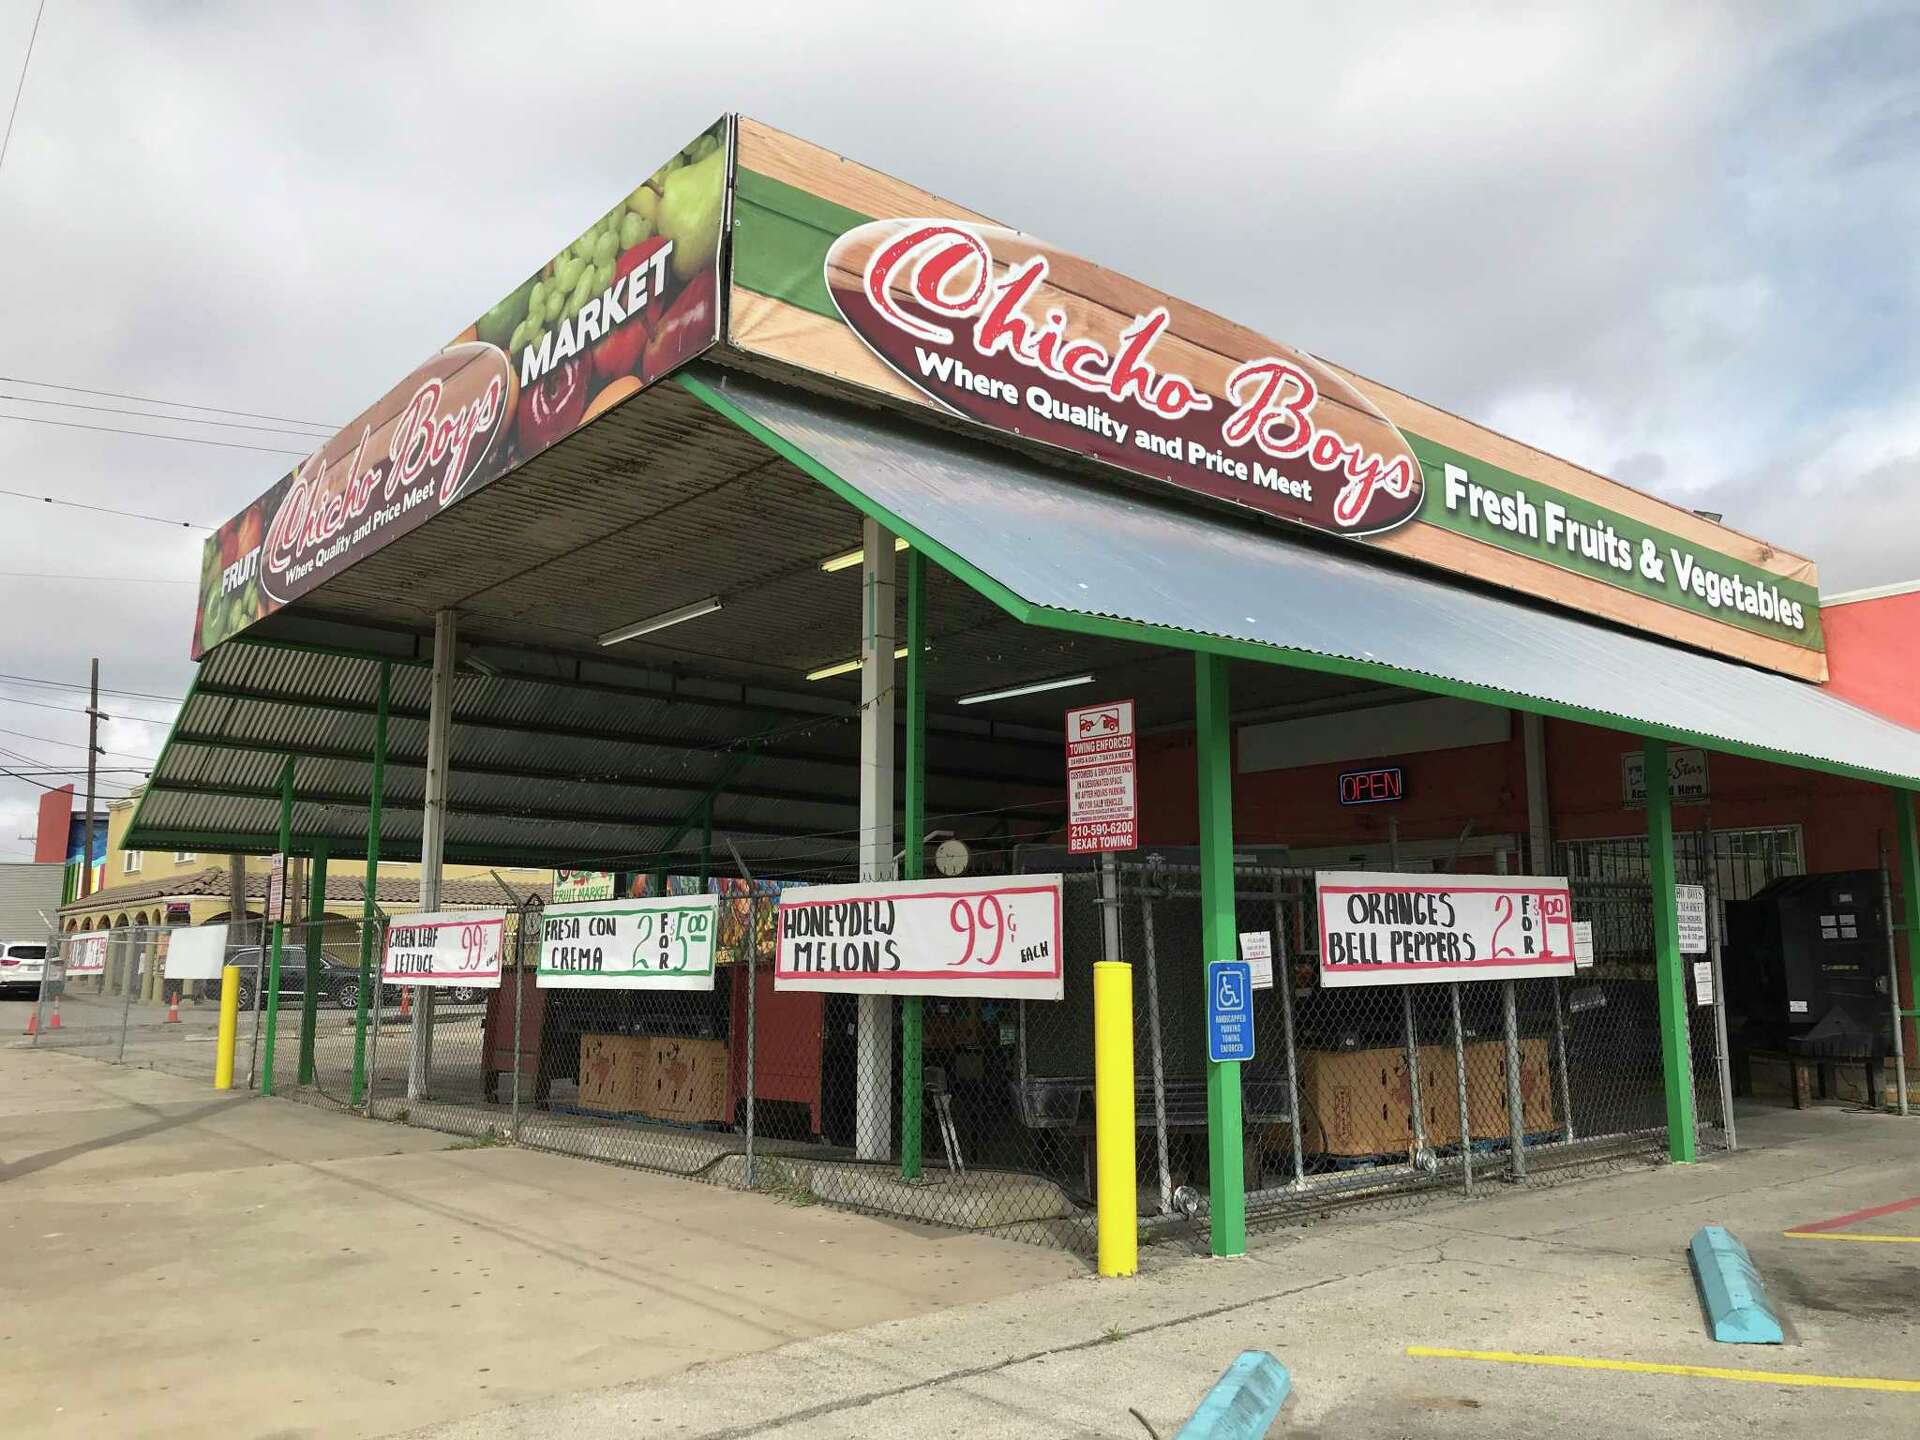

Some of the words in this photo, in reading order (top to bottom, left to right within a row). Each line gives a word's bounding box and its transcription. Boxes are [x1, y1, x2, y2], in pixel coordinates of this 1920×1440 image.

[520, 239, 673, 388] MARKET
[864, 220, 1212, 417] Chicho
[1222, 357, 1413, 525] Boys
[385, 376, 501, 506] Boys
[914, 346, 1020, 406] Where
[1026, 389, 1129, 444] Quality
[1135, 426, 1183, 461] and
[1188, 441, 1248, 482] Price
[1252, 461, 1313, 503] Meet
[284, 555, 314, 588] Where
[315, 533, 351, 571] Quality
[352, 516, 373, 545] and
[372, 502, 402, 533] Price
[402, 477, 436, 515] Meet
[1444, 462, 1538, 539] Fresh
[1544, 500, 1632, 571] Fruits
[1639, 538, 1665, 584] &
[1670, 547, 1804, 630] Vegetables
[220, 545, 261, 599] FRUIT
[1070, 741, 1095, 755] TOWING
[1096, 736, 1131, 751] ENFORCED
[1343, 772, 1400, 800] OPEN
[1072, 822, 1133, 837] 210-590-6200
[1072, 838, 1098, 851] BEXAR
[1100, 834, 1133, 849] TOWING
[578, 885, 610, 899] MARKET
[783, 900, 896, 939] HONEYDEW
[1347, 892, 1456, 928] ORANGES
[1491, 895, 1516, 959] 2
[418, 927, 438, 948] LEAF
[544, 918, 580, 942] FRESA
[588, 916, 617, 938] CON
[632, 915, 654, 969] 2
[551, 946, 604, 972] CREMA
[794, 938, 901, 973] MELONS
[1020, 940, 1049, 963] EACH
[1328, 931, 1383, 965] BELL
[1391, 931, 1476, 964] PEPPERS
